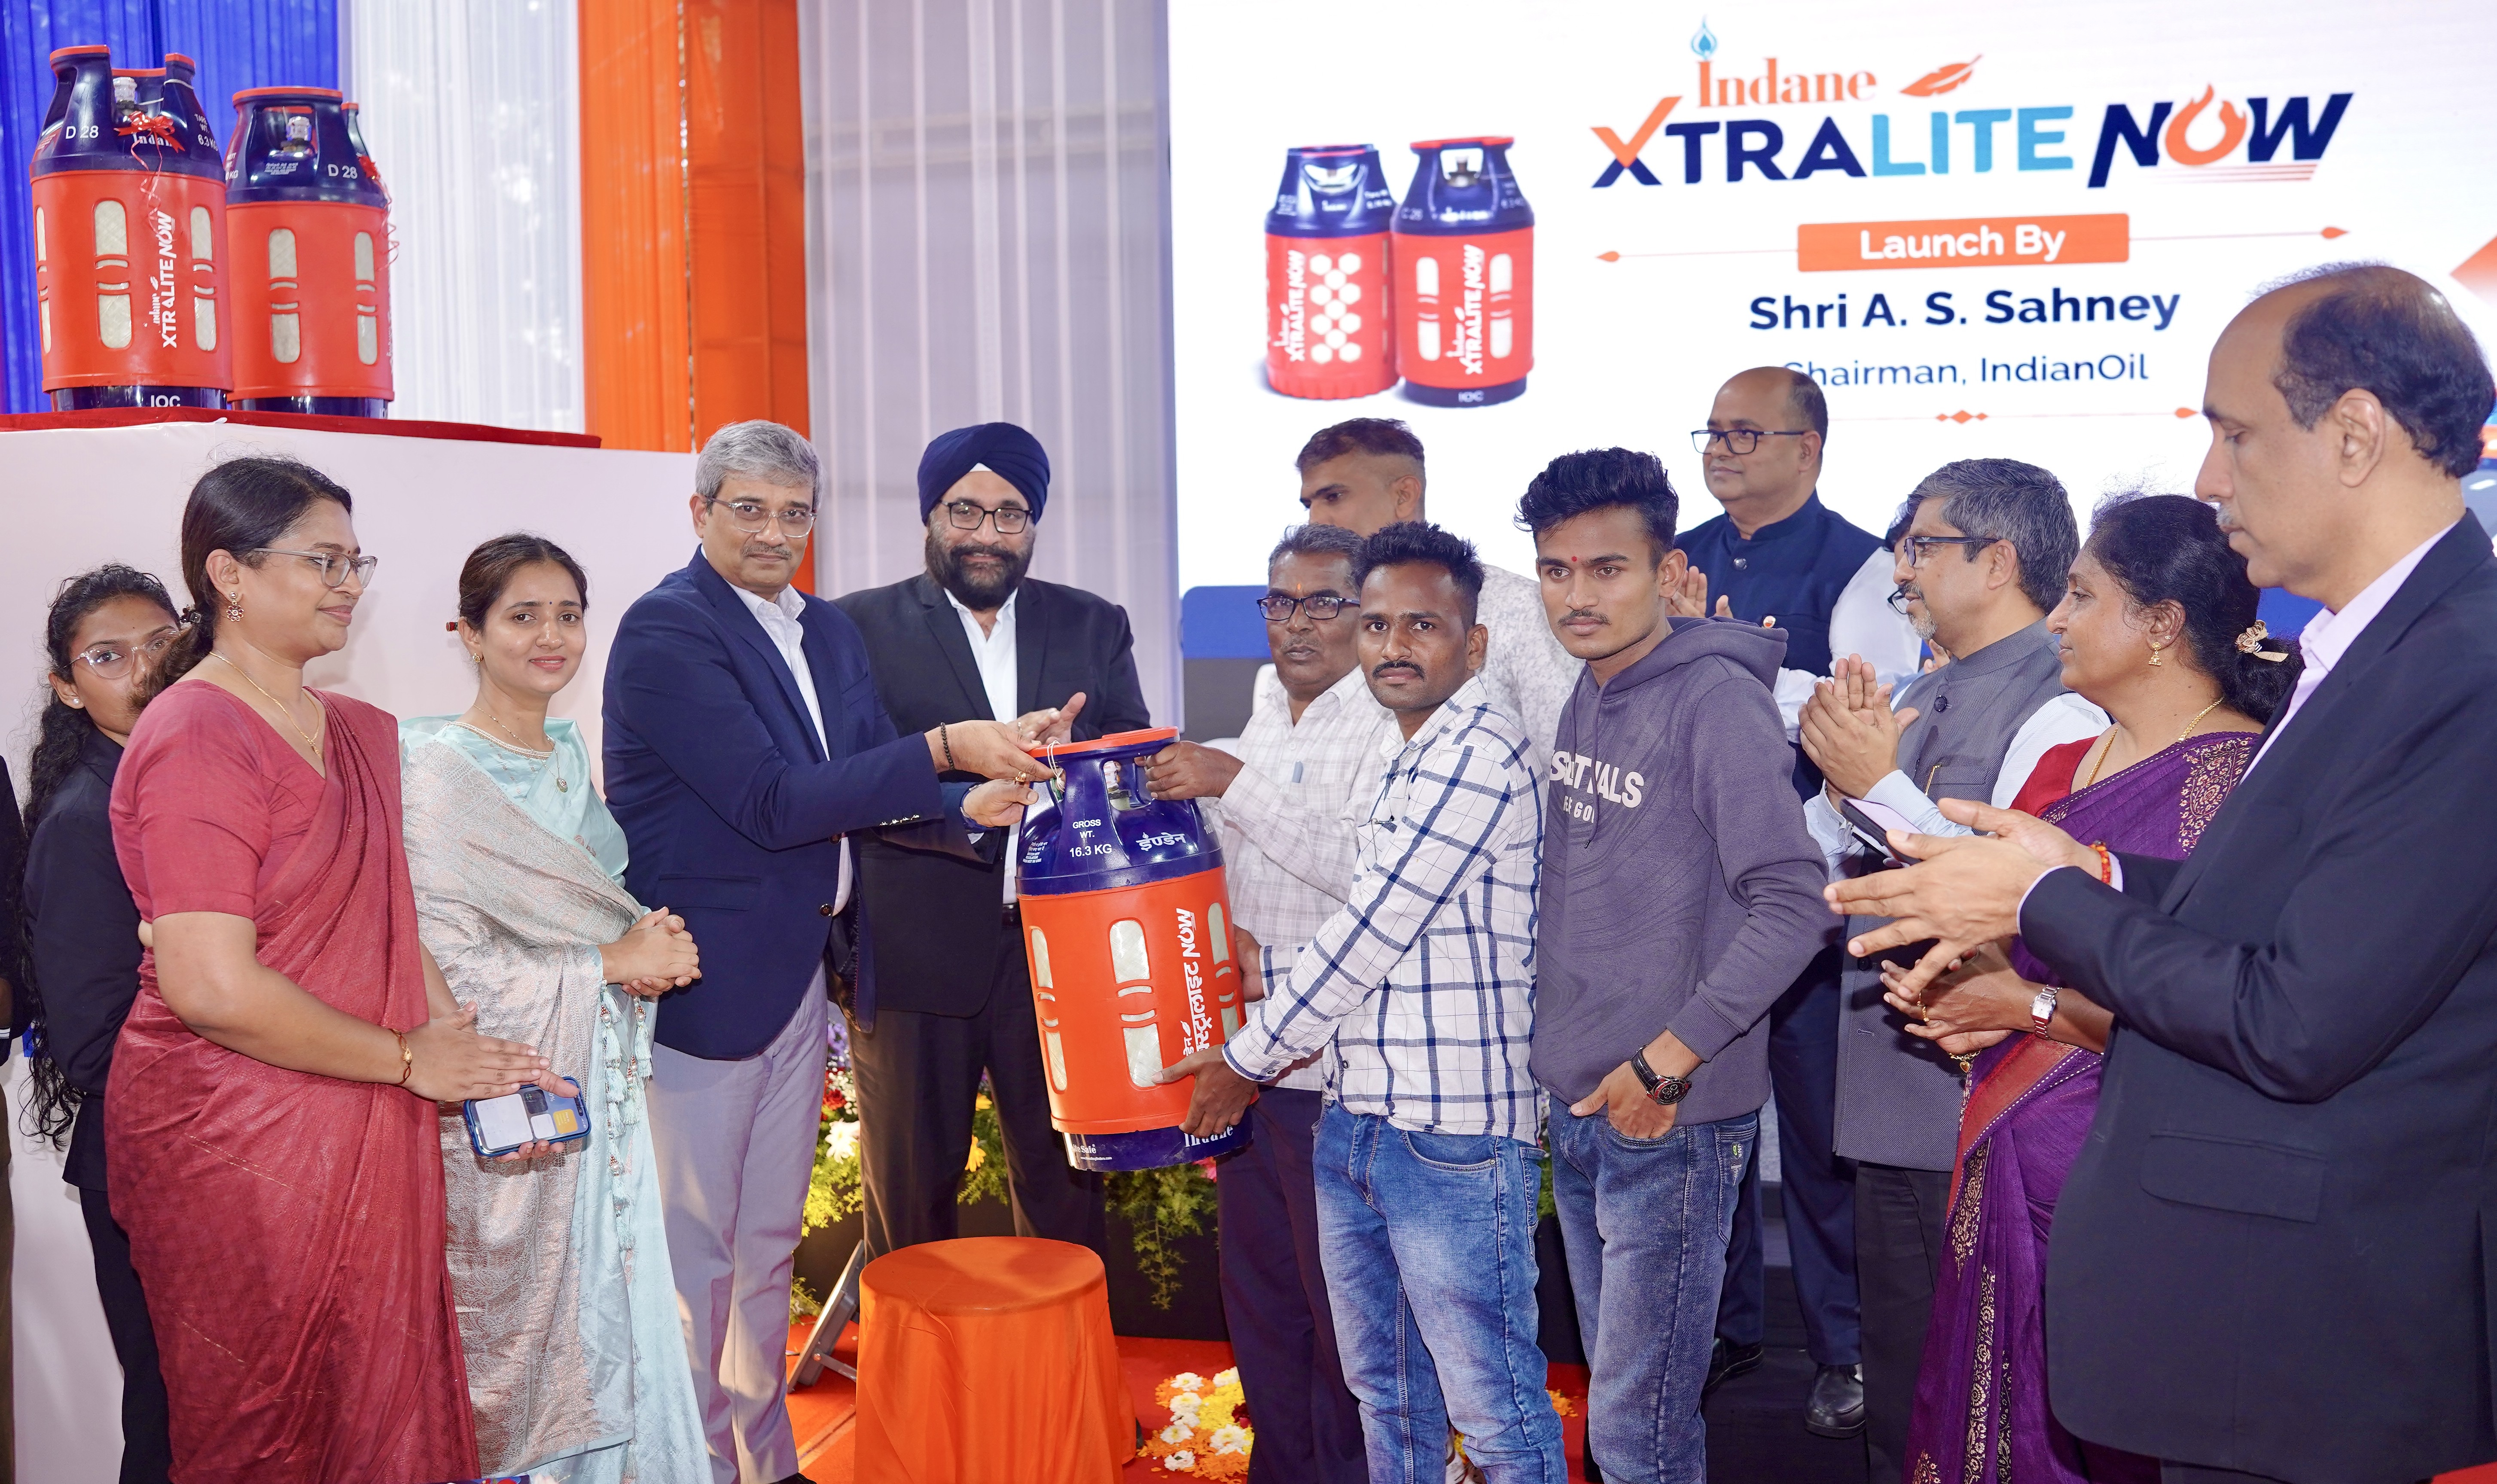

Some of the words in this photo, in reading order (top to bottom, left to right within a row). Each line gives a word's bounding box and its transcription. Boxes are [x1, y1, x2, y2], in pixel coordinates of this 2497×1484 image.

[1697, 58, 1876, 108] Indane
[65, 126, 76, 140] D
[79, 125, 99, 139] 28
[1591, 96, 2076, 189] XTRALITE
[2087, 83, 2354, 189] NOW
[327, 164, 339, 177] D
[341, 166, 358, 179] 28
[155, 210, 177, 259] NOW
[1860, 225, 2004, 259] Launch
[2015, 224, 2066, 262] By
[1462, 244, 1485, 289] NOW
[159, 258, 177, 348] XTRALITE
[1750, 294, 1848, 330] Shri
[1862, 293, 1907, 327] A.
[1925, 291, 1967, 325] S.
[1985, 287, 2181, 331] Sahney
[1459, 289, 1483, 375] XTRALITE
[1982, 353, 2149, 382] IndianOil
[150, 394, 181, 408] IOC
[1072, 819, 1101, 829] GROSS
[1079, 830, 1095, 839] WT.
[1135, 832, 1186, 851] इण्डेन
[1069, 845, 1092, 858] 16.3
[1094, 843, 1113, 855] KG
[1176, 907, 1201, 958] NOW
